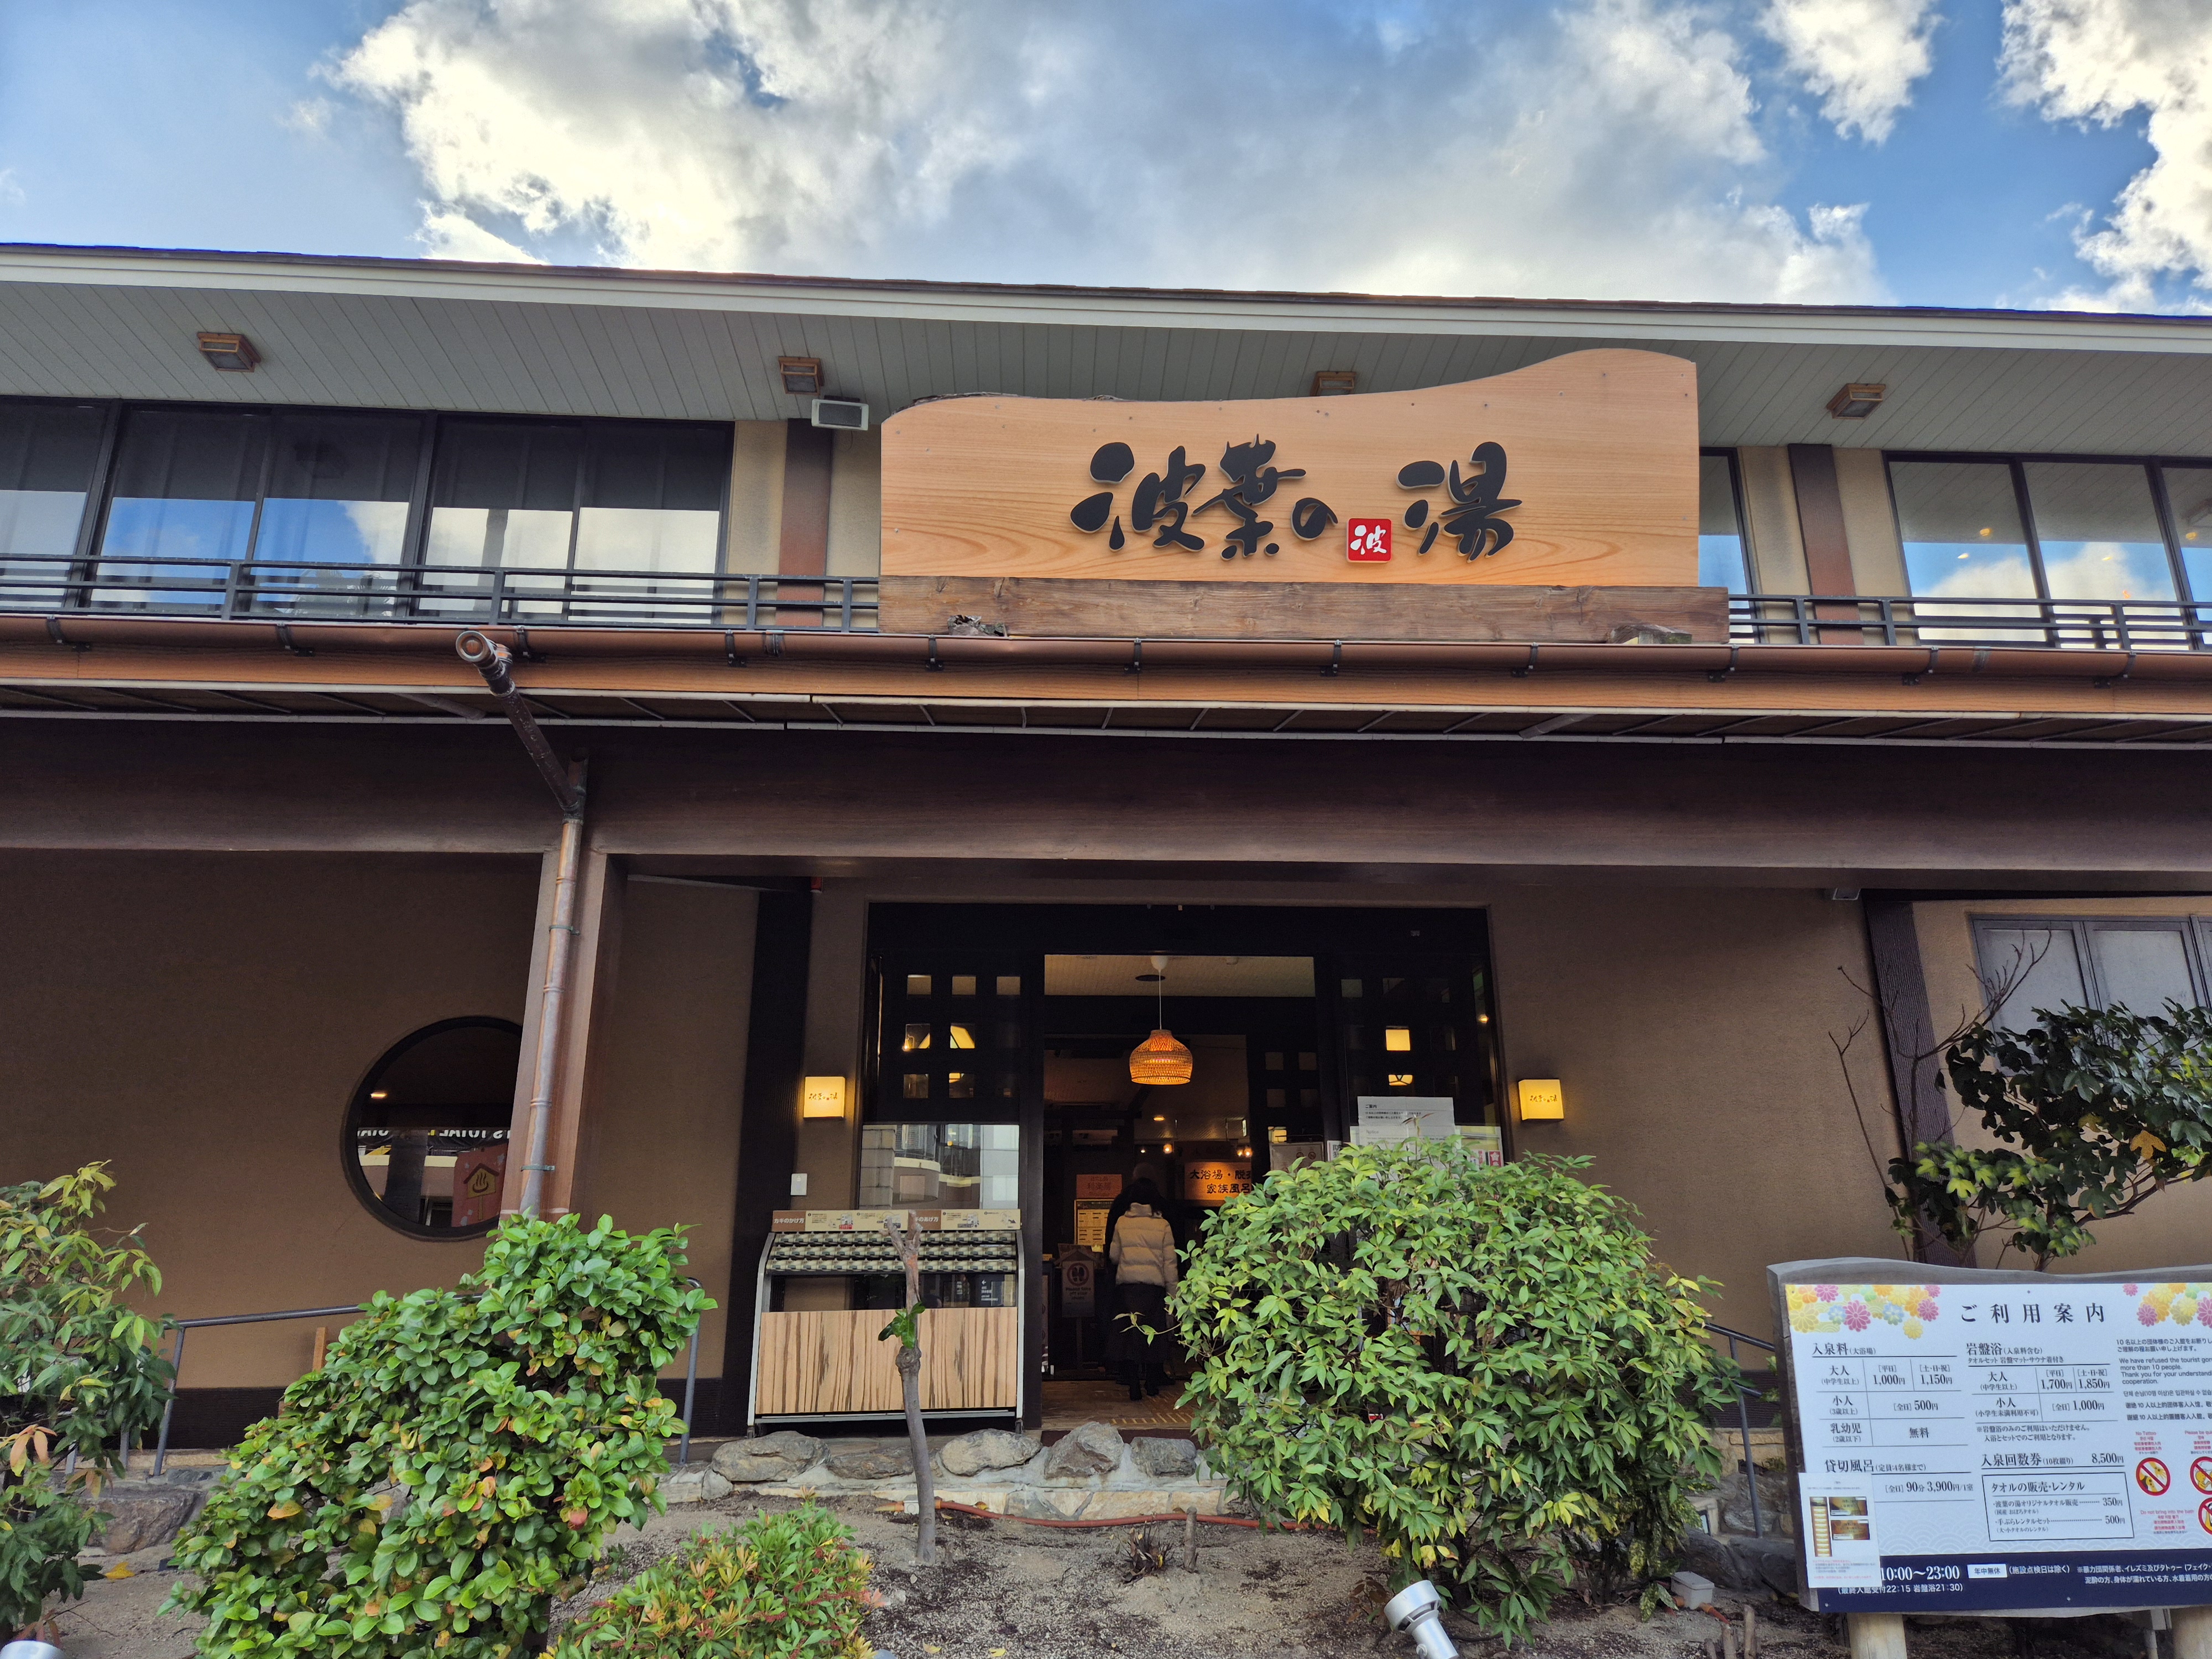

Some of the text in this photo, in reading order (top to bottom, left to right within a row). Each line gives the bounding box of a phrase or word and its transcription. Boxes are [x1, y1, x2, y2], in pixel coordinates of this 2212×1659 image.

[1350, 524, 1389, 555] 波
[1207, 1183, 1250, 1193] 家族風呂
[1961, 1303, 2105, 1323] ご利用案内
[1829, 1365, 1850, 1376] 大人
[1873, 1374, 1906, 1385] 1,000円
[1920, 1374, 1953, 1385] 1,150円
[1987, 1371, 2008, 1382] 大人
[2041, 1379, 2073, 1390] 1,700円
[2078, 1379, 2110, 1389] 1,850円
[1833, 1395, 1853, 1406] 小人
[1914, 1400, 1938, 1411] 500円
[1996, 1397, 2016, 1407] 小人
[2073, 1400, 2104, 1411] 1,000円
[1830, 1423, 1862, 1434] 乳幼児
[1909, 1427, 1929, 1438] 無料
[2091, 1453, 2124, 1464] 8,500円
[1906, 1481, 1925, 1493] 90分
[1991, 1481, 2085, 1493] タオルの販売・レンタル
[2103, 1498, 2123, 1506] 350円
[2105, 1515, 2125, 1524] 500円
[1974, 1567, 2001, 1575] 年中無休
